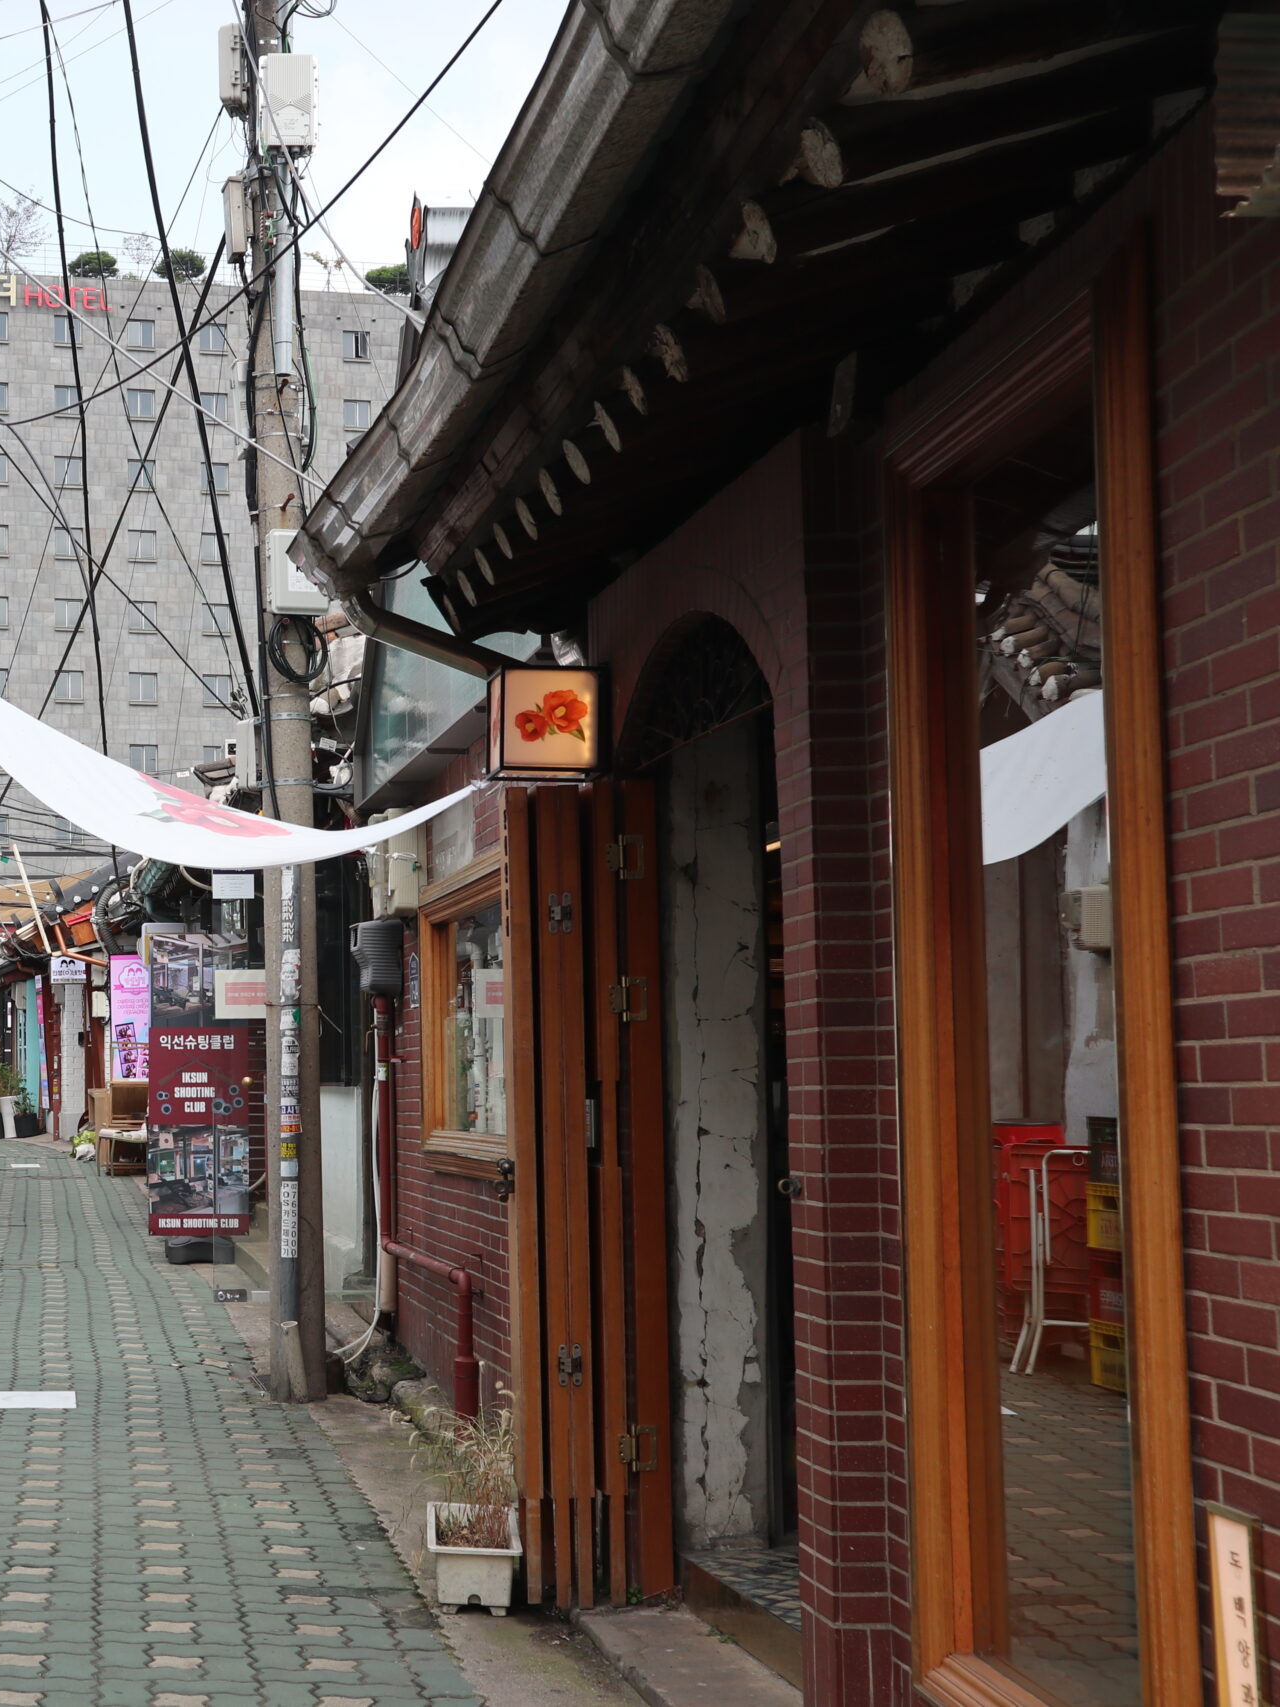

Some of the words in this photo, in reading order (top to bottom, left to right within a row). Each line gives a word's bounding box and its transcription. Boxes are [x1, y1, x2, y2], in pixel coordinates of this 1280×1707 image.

[25, 284, 112, 311] HOTEL
[159, 1034, 235, 1050] 익선슈팅클럽
[182, 1072, 208, 1083] IKSUN
[174, 1087, 215, 1098] SHOOTING
[184, 1101, 206, 1112] CLUB
[158, 1218, 180, 1228] IKSUN
[183, 1218, 218, 1228] SHOOTING
[220, 1218, 239, 1228] CLUB
